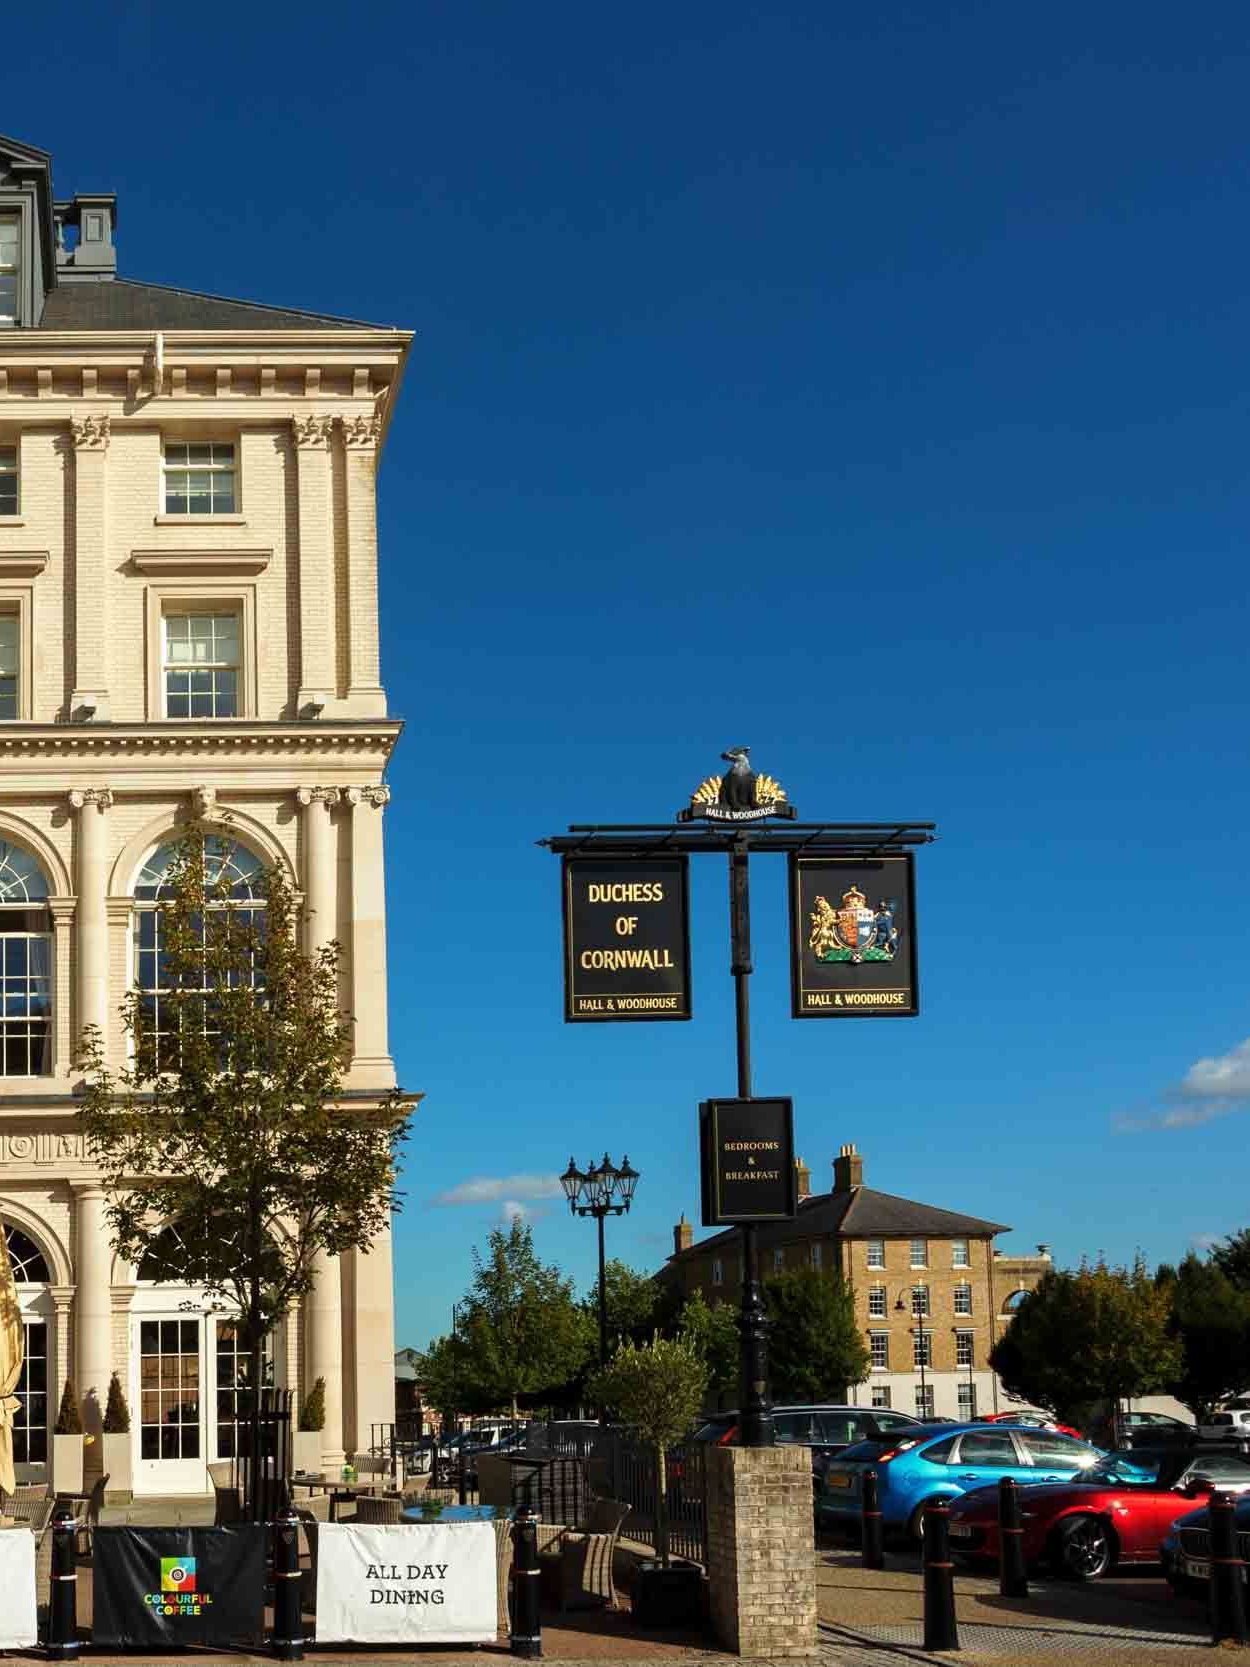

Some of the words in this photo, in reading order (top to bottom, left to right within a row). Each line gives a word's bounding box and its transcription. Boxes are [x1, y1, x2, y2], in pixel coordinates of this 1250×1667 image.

[705, 807, 724, 818] HALL
[725, 811, 732, 820] &
[732, 806, 777, 820] WOODHOUSE
[588, 883, 663, 903] DUCHESS
[615, 916, 639, 936] OF
[581, 949, 674, 971] CORNWALL
[579, 999, 604, 1011] HALL
[606, 999, 616, 1011] &
[617, 997, 678, 1009] WOODHOUSE
[807, 994, 832, 1007] HALL
[834, 994, 844, 1006] &
[844, 993, 905, 1005] WOODHOUSE
[724, 1141, 780, 1151] BEDROOMS
[747, 1156, 756, 1166] &
[725, 1170, 780, 1180] BREAKFAST
[366, 1564, 402, 1580] ALL
[406, 1564, 449, 1580] DAY
[144, 1593, 213, 1604] COLOURFUL
[370, 1589, 445, 1605] DINING
[156, 1605, 202, 1616] COFFEE
